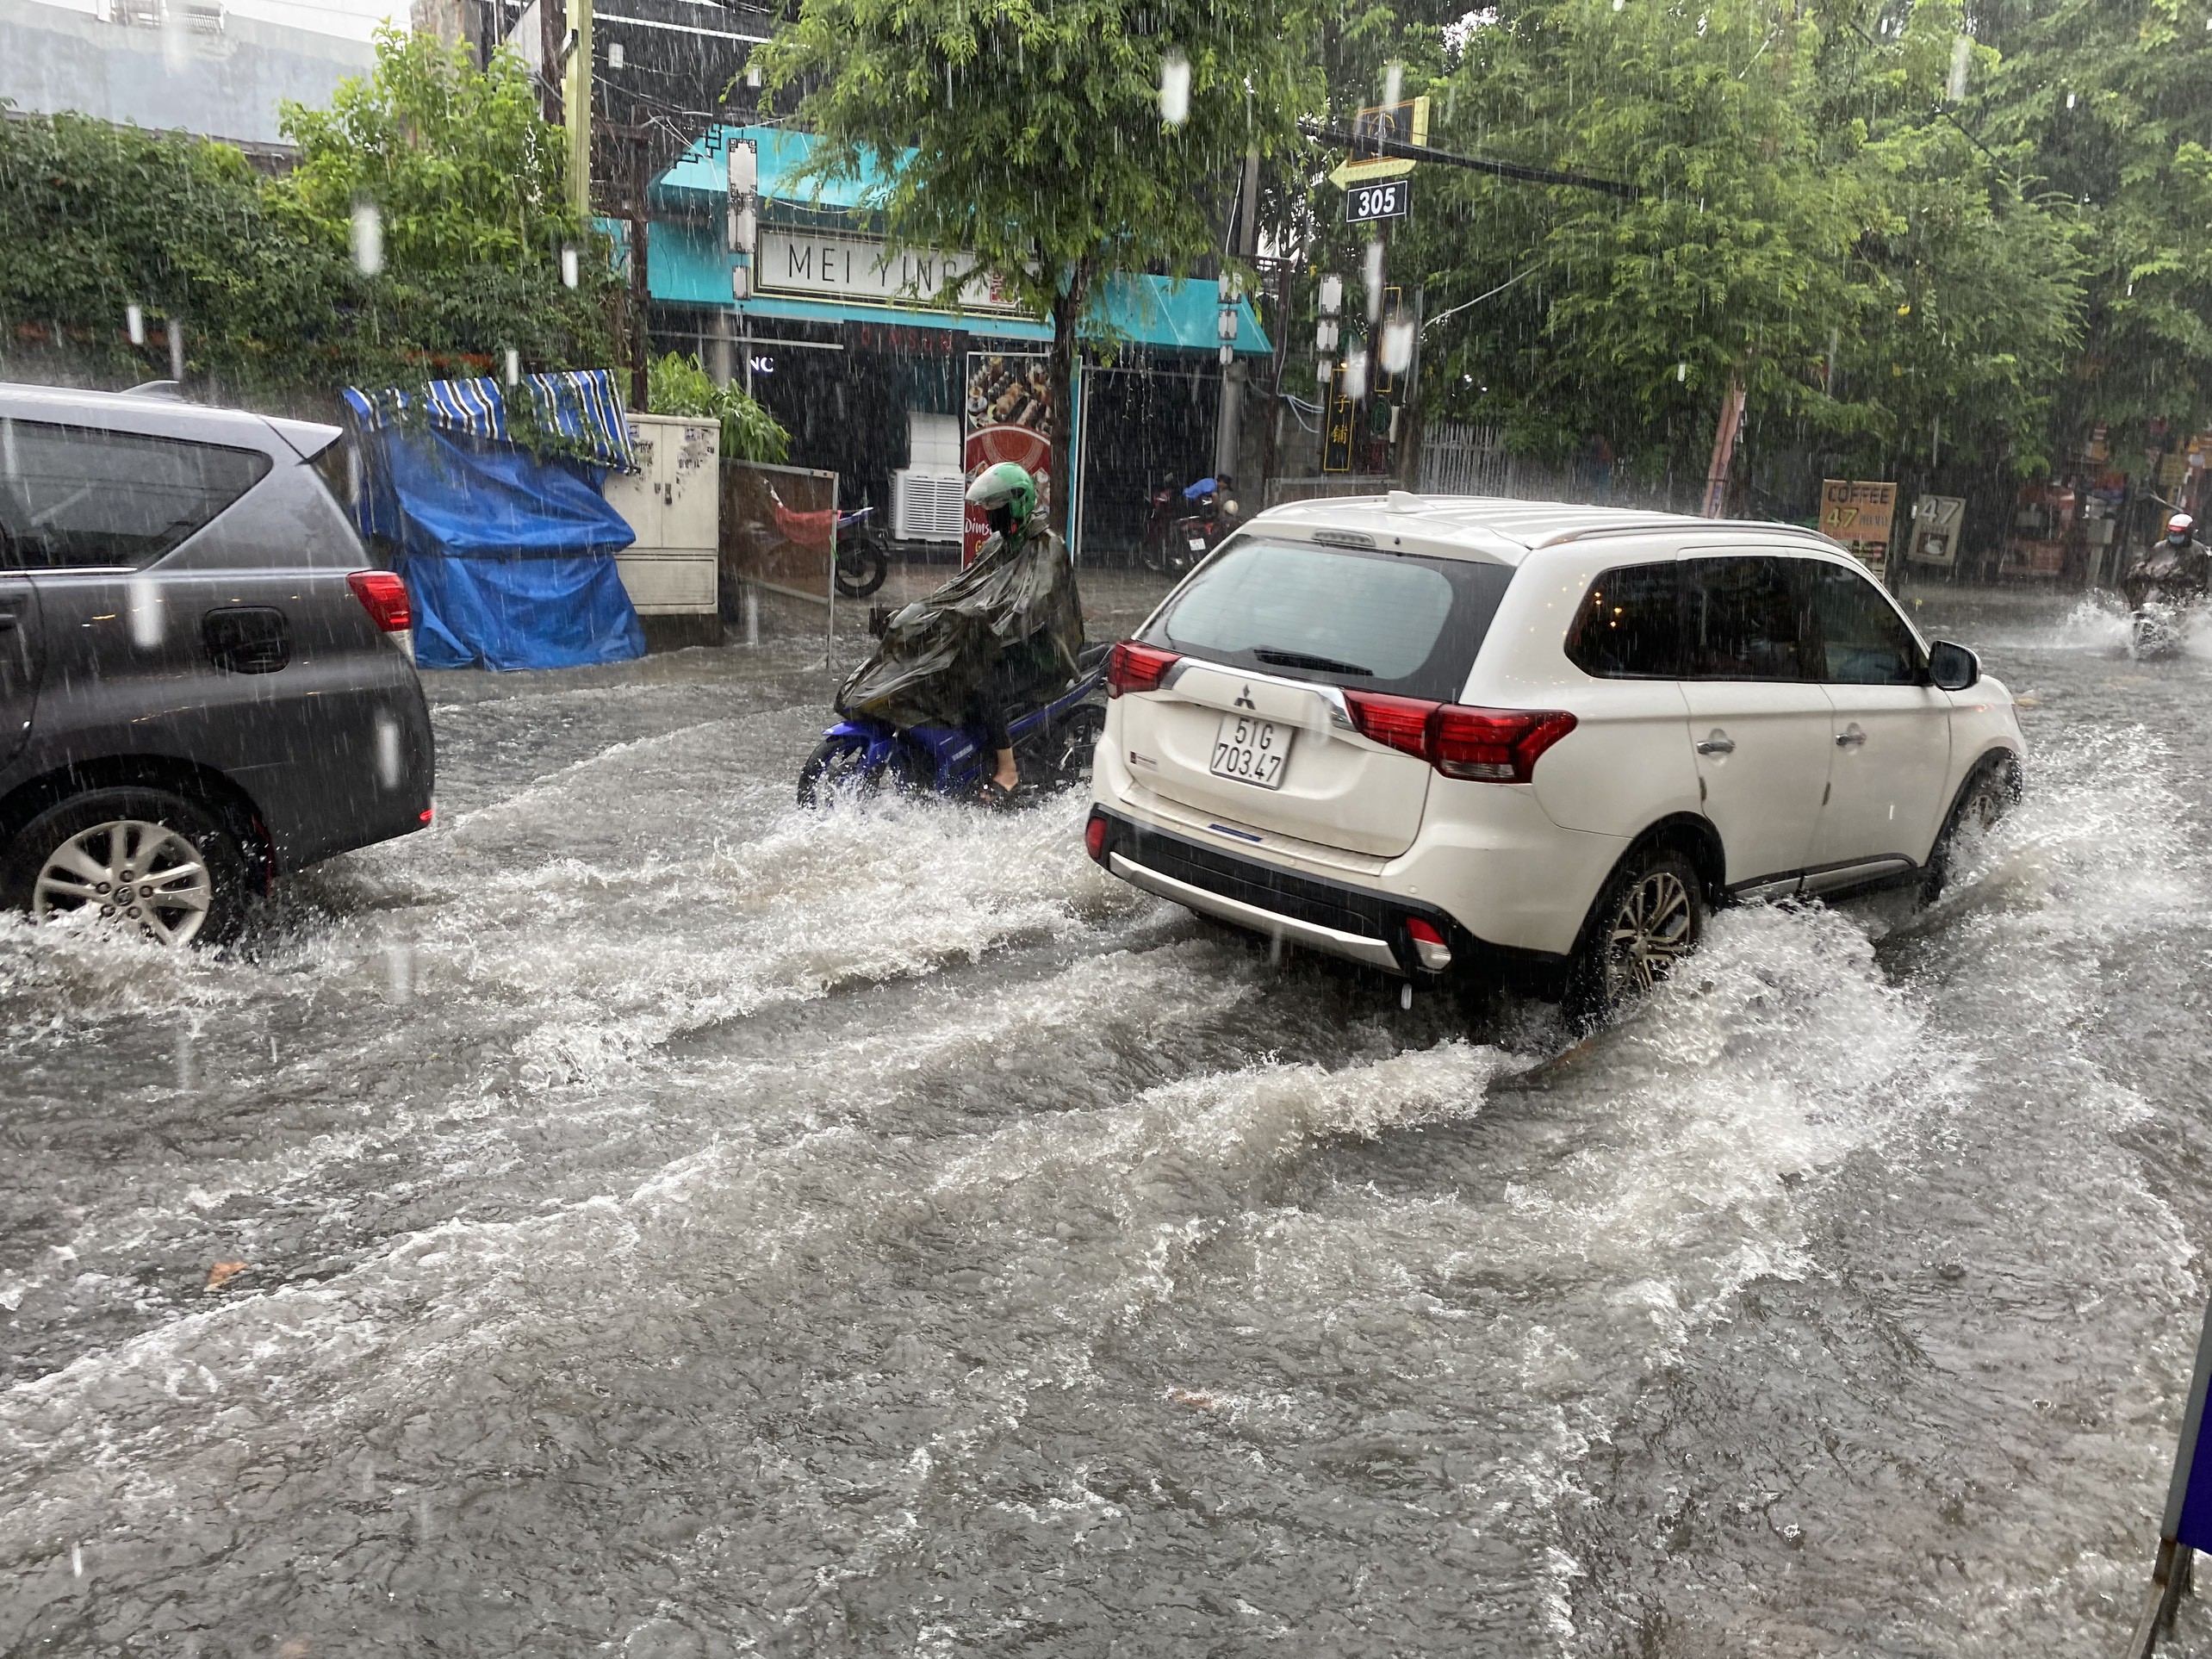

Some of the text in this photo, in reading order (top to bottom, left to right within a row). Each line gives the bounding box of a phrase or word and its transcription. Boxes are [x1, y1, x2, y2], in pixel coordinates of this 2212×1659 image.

[1358, 187, 1395, 216] 305
[788, 244, 851, 283] MEI
[1828, 485, 1890, 505] COFFEE
[1827, 507, 1859, 528] 47
[1918, 498, 1960, 525] 47
[1234, 718, 1272, 749] 51G
[1215, 743, 1281, 780] 703.47
